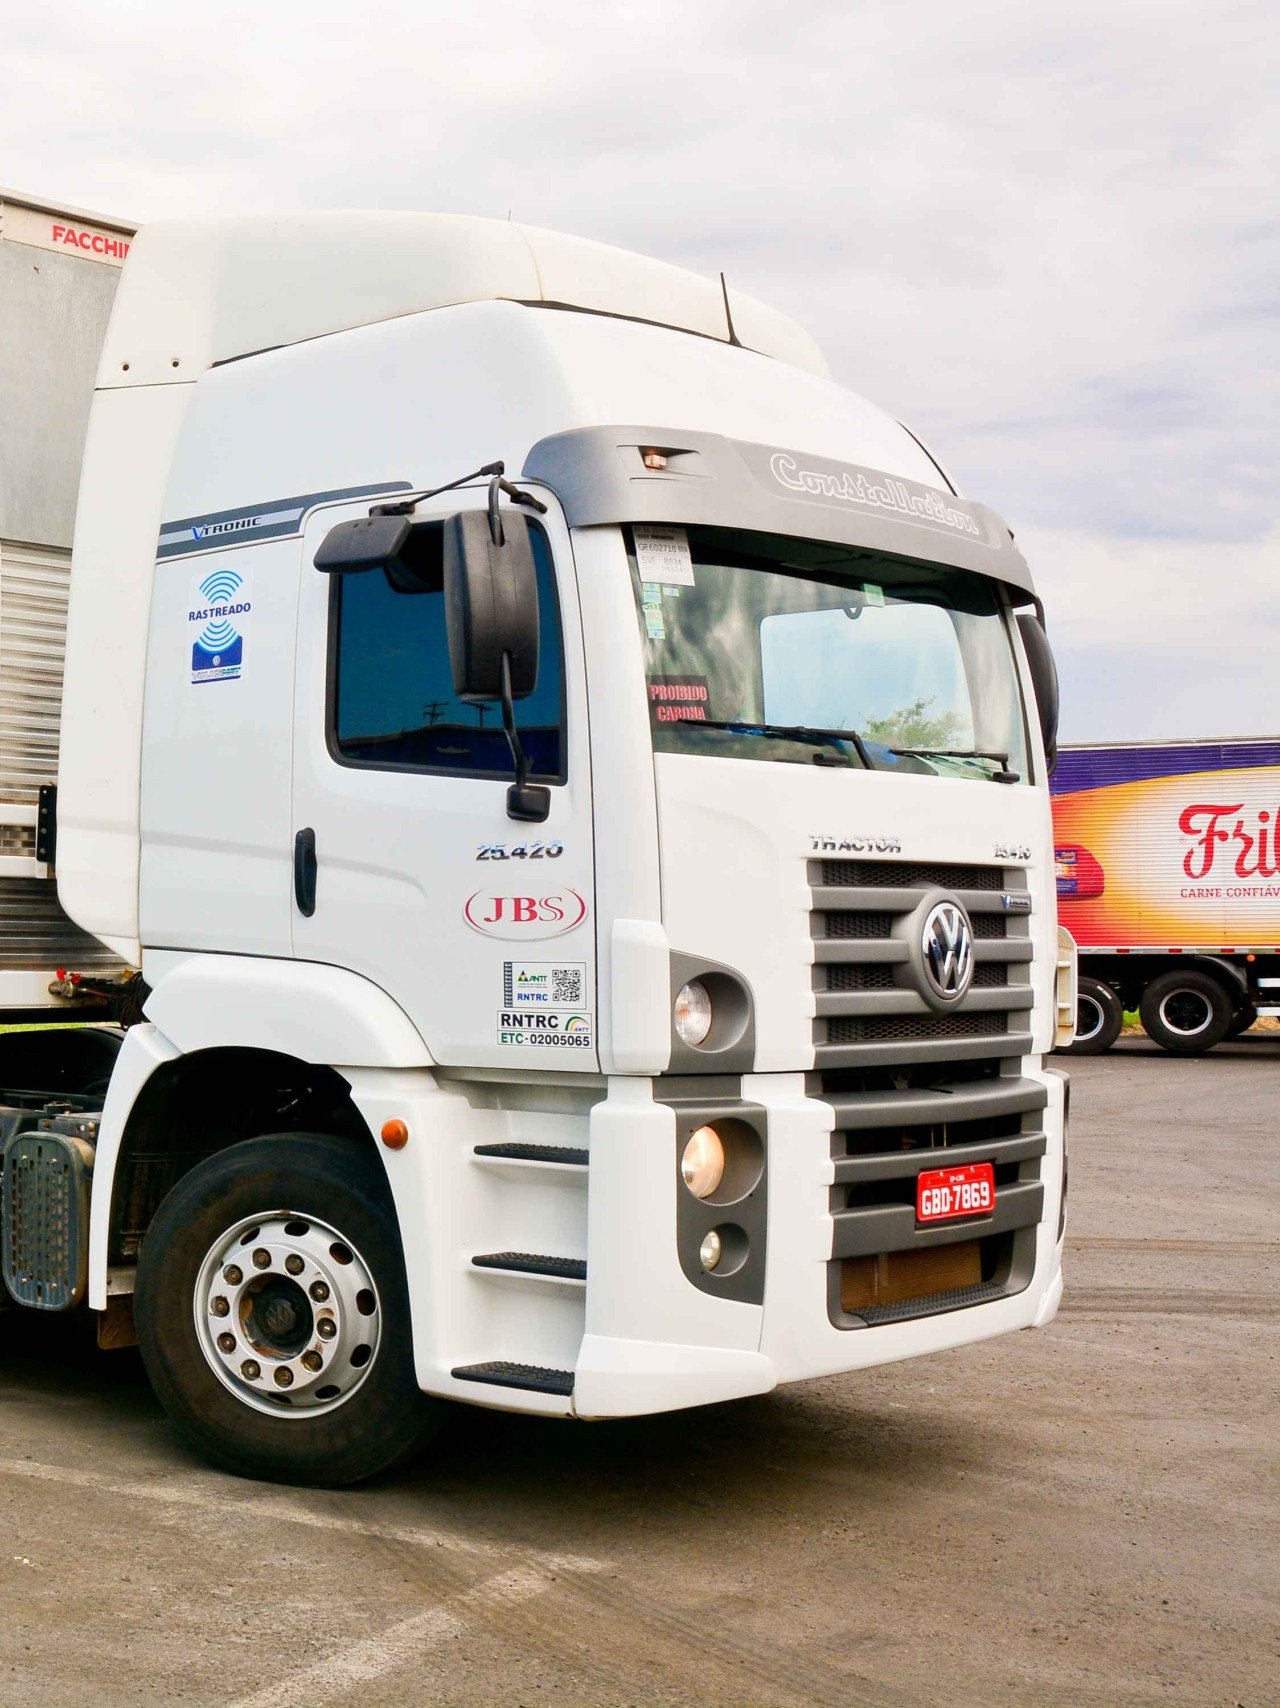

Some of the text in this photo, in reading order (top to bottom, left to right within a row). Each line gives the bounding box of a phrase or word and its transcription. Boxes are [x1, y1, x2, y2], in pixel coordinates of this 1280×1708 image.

[770, 453, 979, 535] Constellation
[188, 602, 251, 622] RASTREADO
[649, 684, 708, 701] PROIBIDO
[656, 705, 706, 722] CARONA
[808, 834, 902, 854] TRACTOR
[1180, 888, 1222, 898] CARNE
[483, 896, 564, 923] JBS
[517, 993, 548, 1001] RNTRC
[500, 1013, 559, 1029] RNTRC
[922, 1181, 990, 1215] GBD-7869
